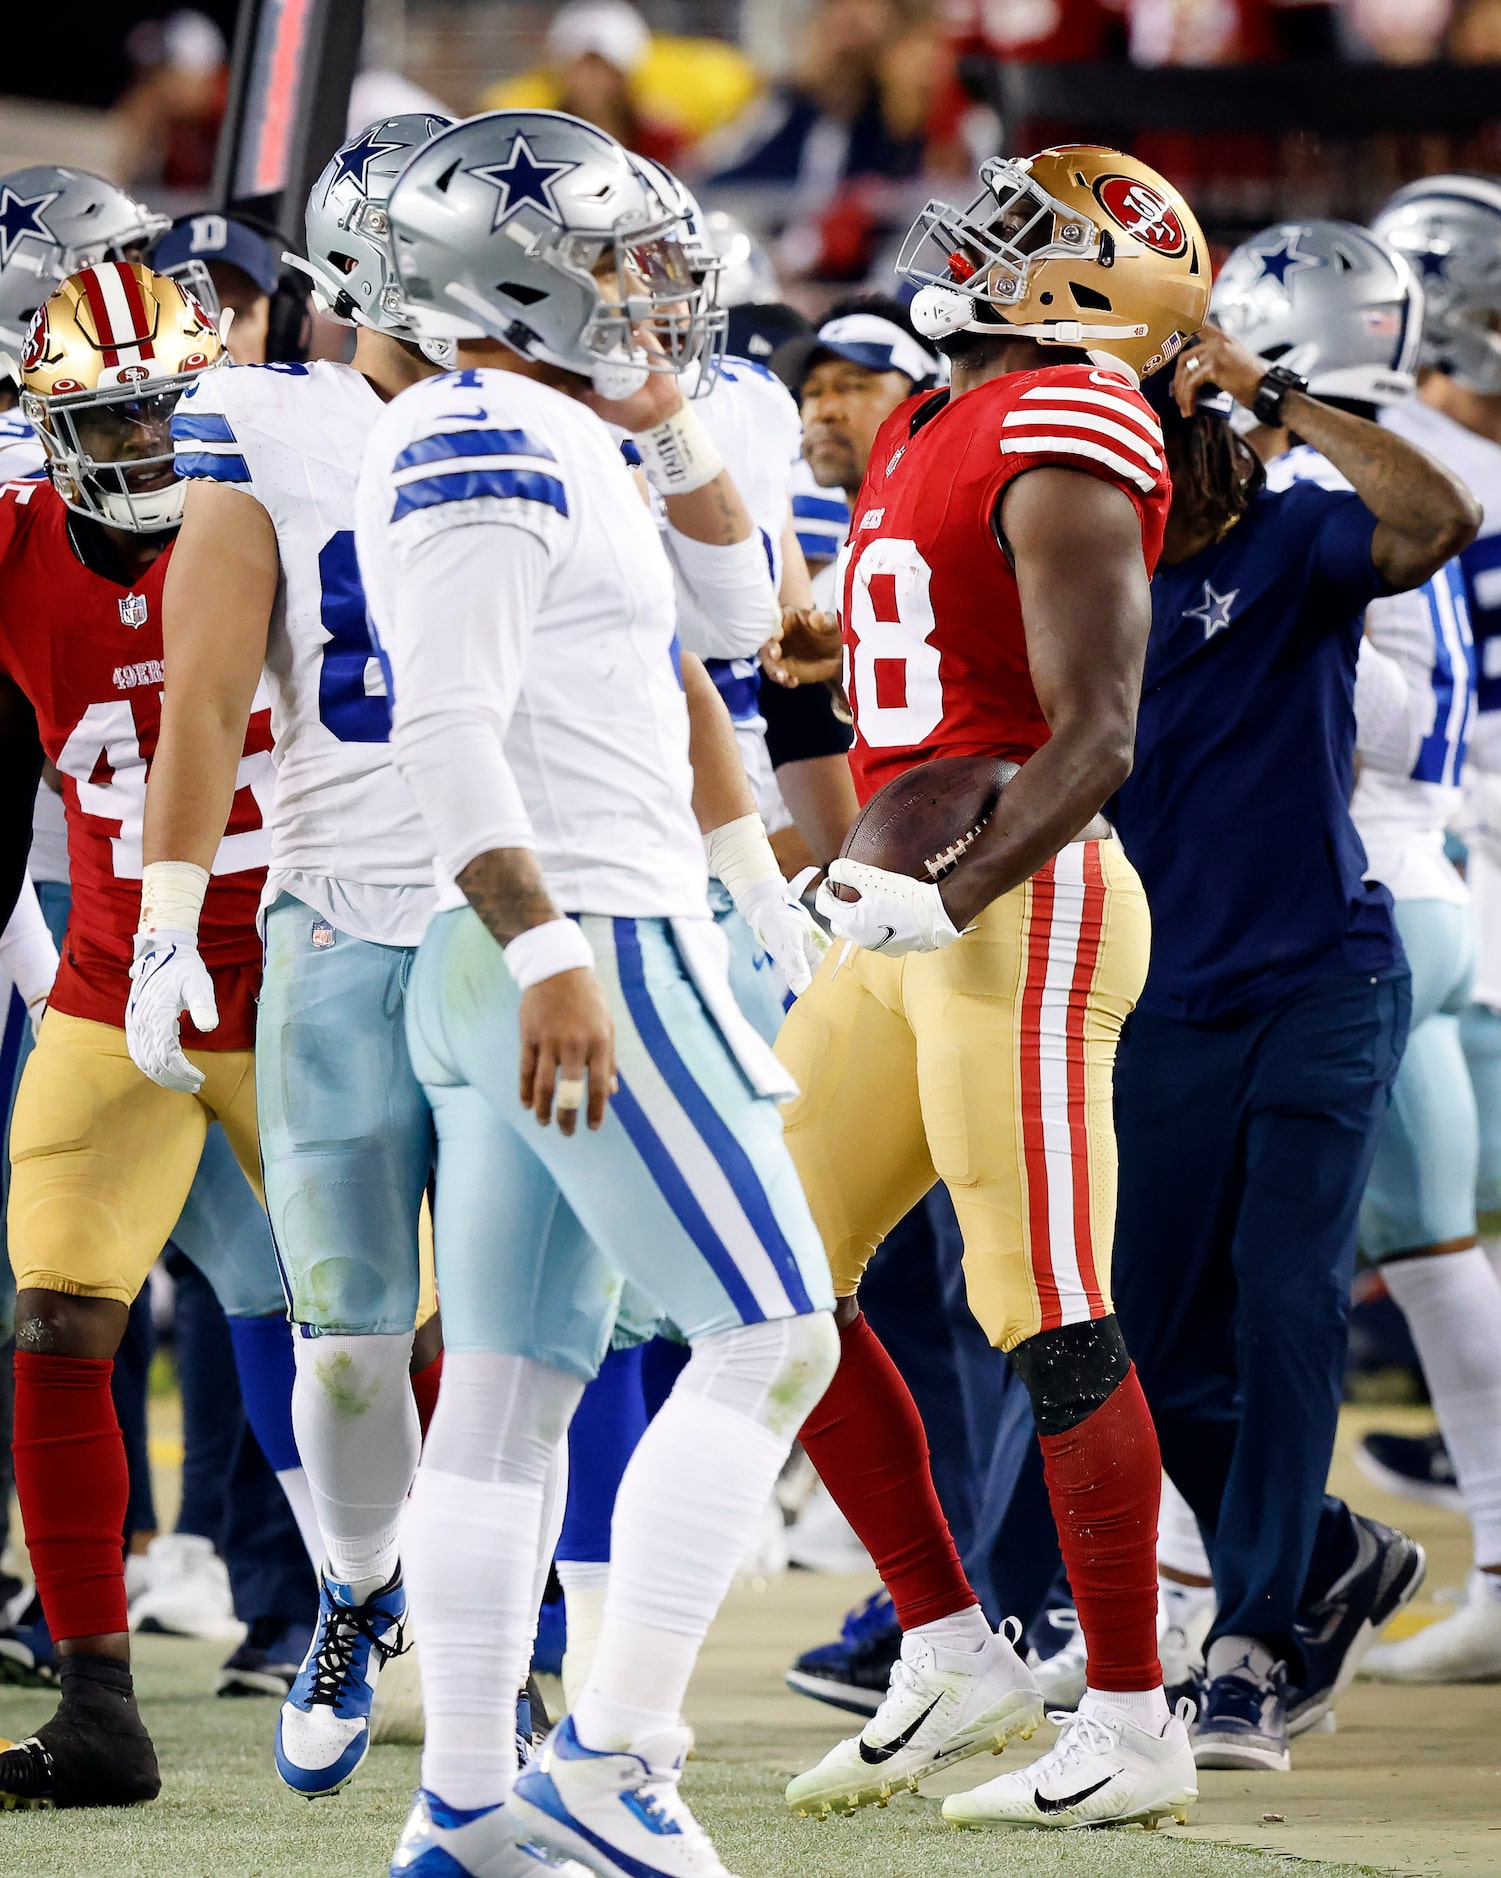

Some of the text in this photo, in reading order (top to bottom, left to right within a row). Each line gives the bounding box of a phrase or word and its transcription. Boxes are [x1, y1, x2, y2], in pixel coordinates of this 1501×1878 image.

[189, 214, 228, 253] D
[1133, 326, 1145, 336] 48
[834, 536, 945, 749] 8
